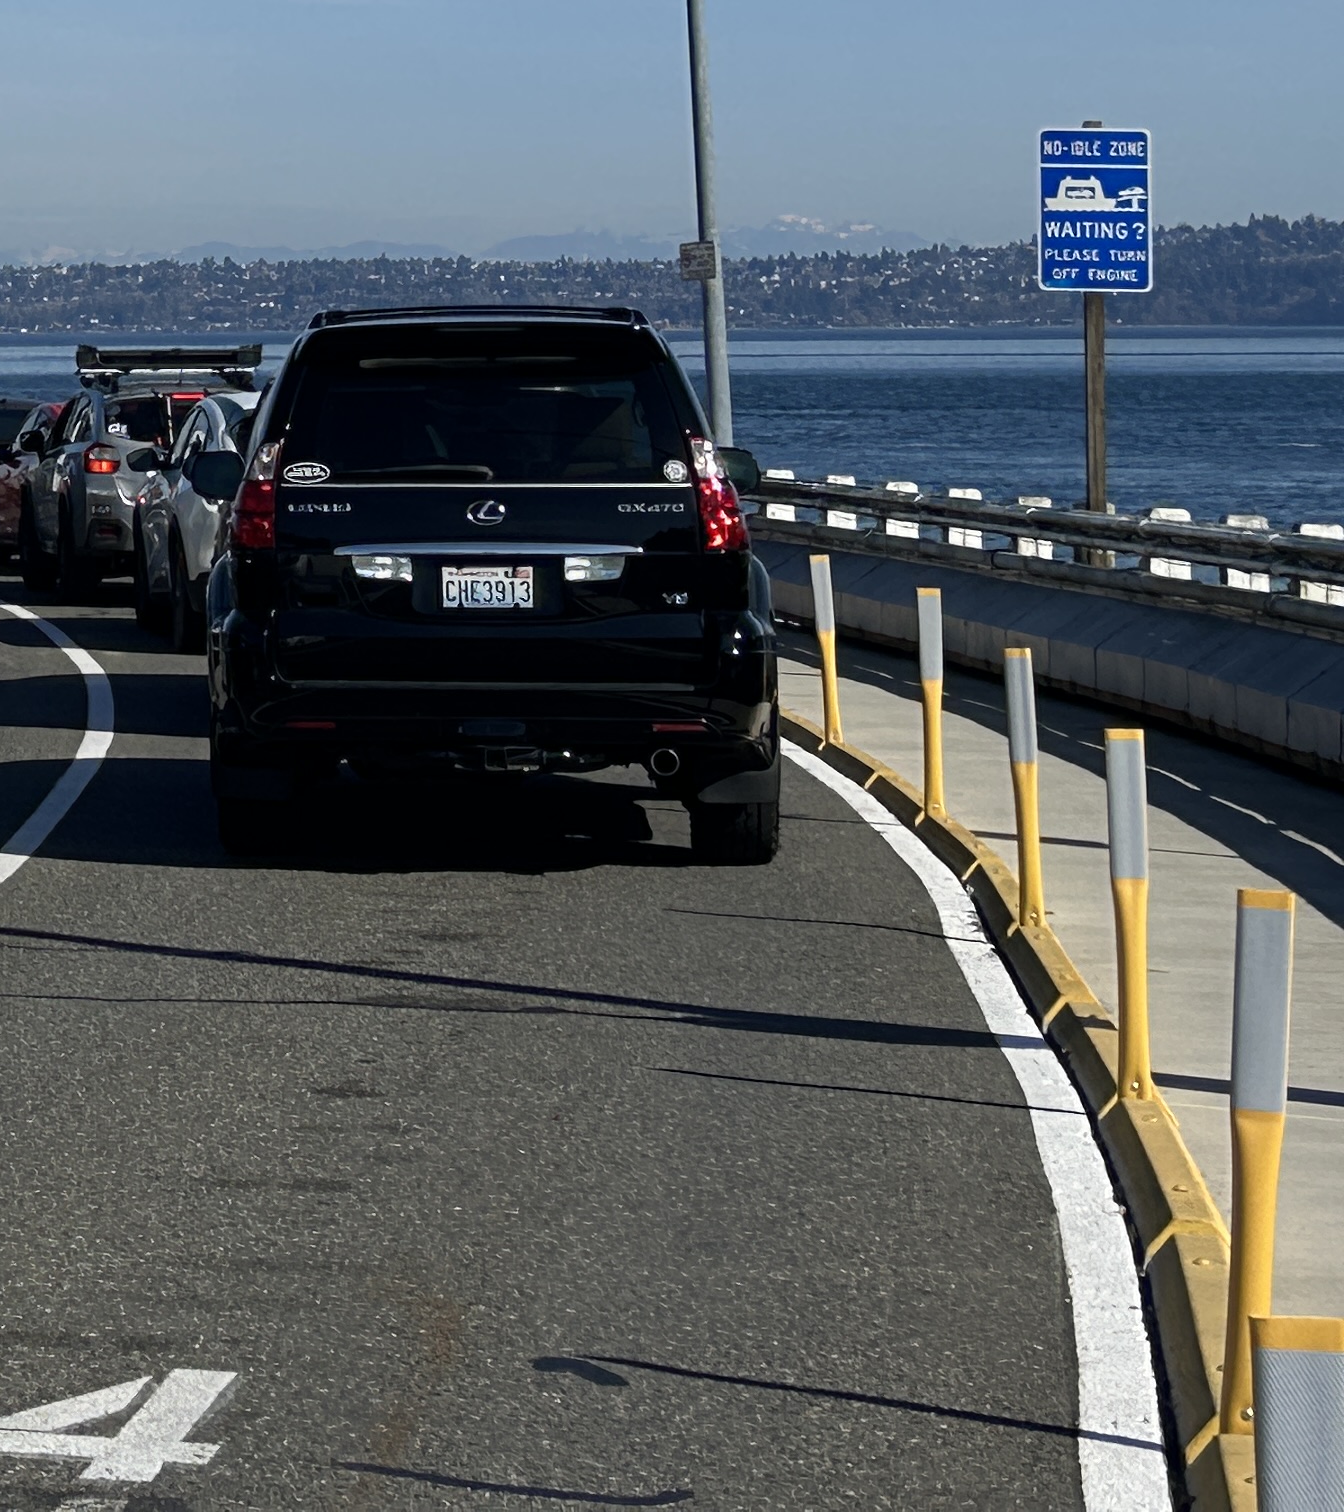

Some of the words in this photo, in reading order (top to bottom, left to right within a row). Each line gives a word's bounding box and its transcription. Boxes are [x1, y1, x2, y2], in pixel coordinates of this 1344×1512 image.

[1043, 140, 1102, 157] NO-IDLE
[1109, 141, 1146, 157] ZONE
[1044, 248, 1100, 262] PLEASE
[1109, 249, 1147, 262] TURN
[1052, 268, 1080, 280] OFF
[1088, 268, 1139, 282] ENGINE
[445, 579, 531, 603] CHE3913
